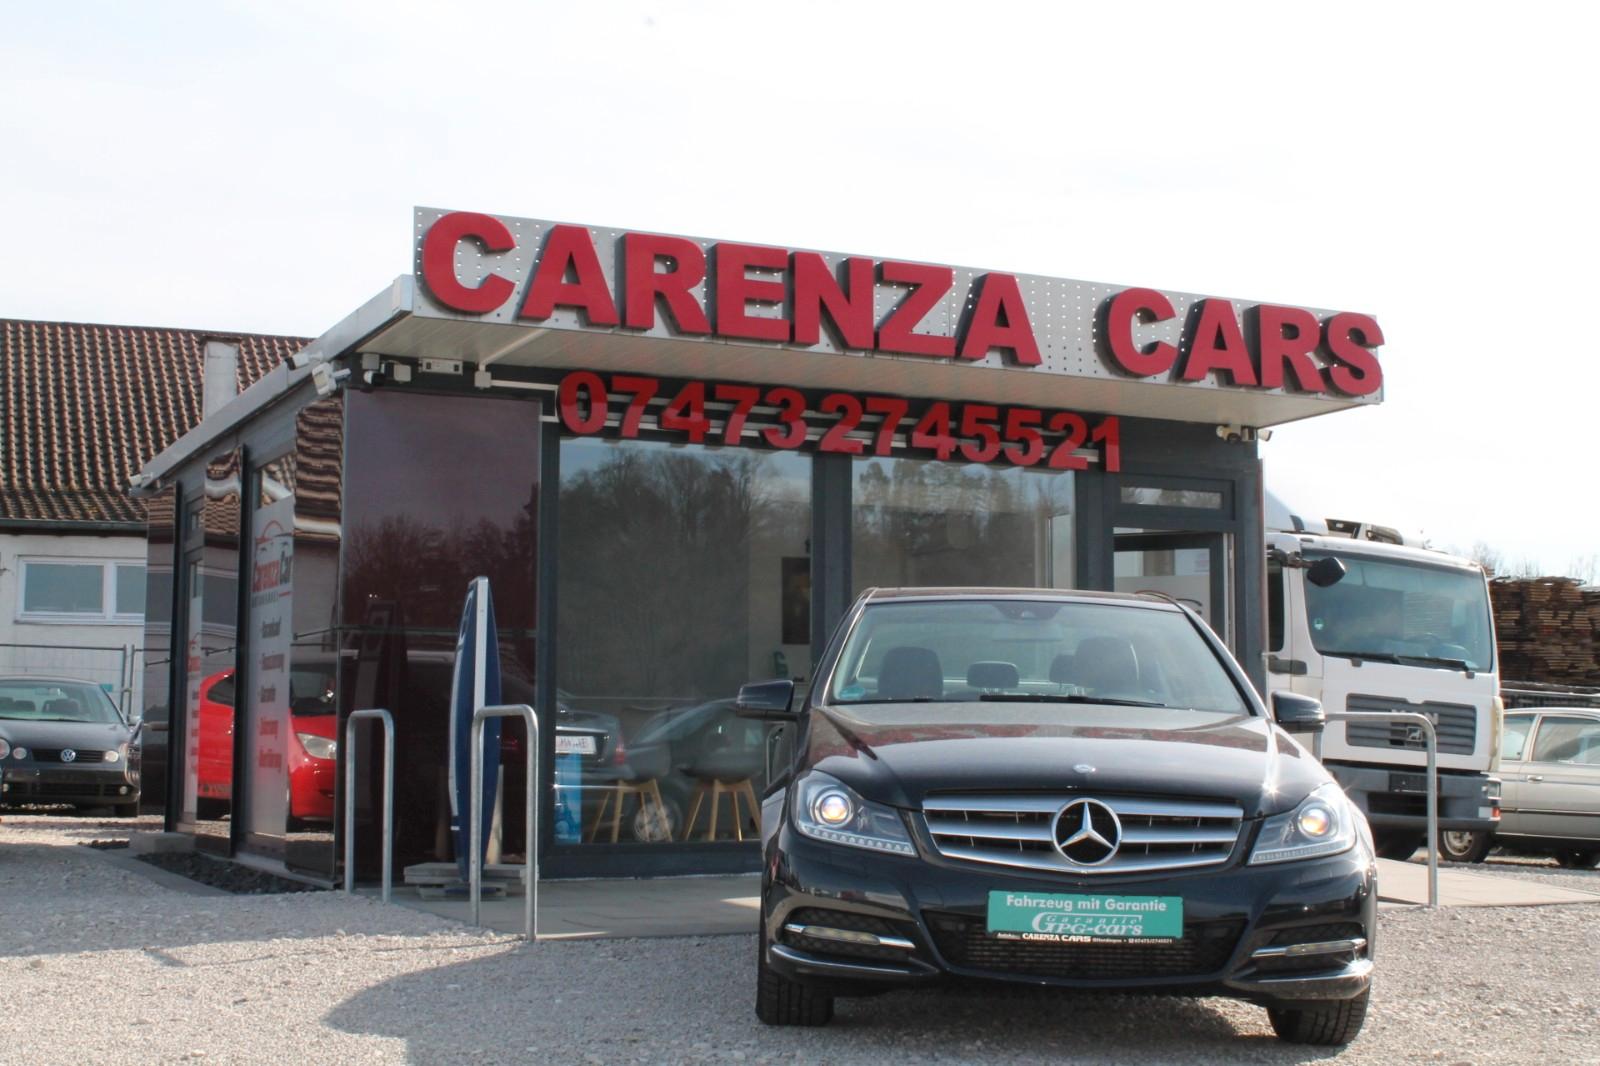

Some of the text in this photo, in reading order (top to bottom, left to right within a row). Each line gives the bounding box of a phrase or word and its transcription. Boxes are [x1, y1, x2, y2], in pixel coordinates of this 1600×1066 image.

[422, 210, 1385, 397] CARENZA CARS
[1006, 895, 1168, 912] Fahrzeug mit Garantie
